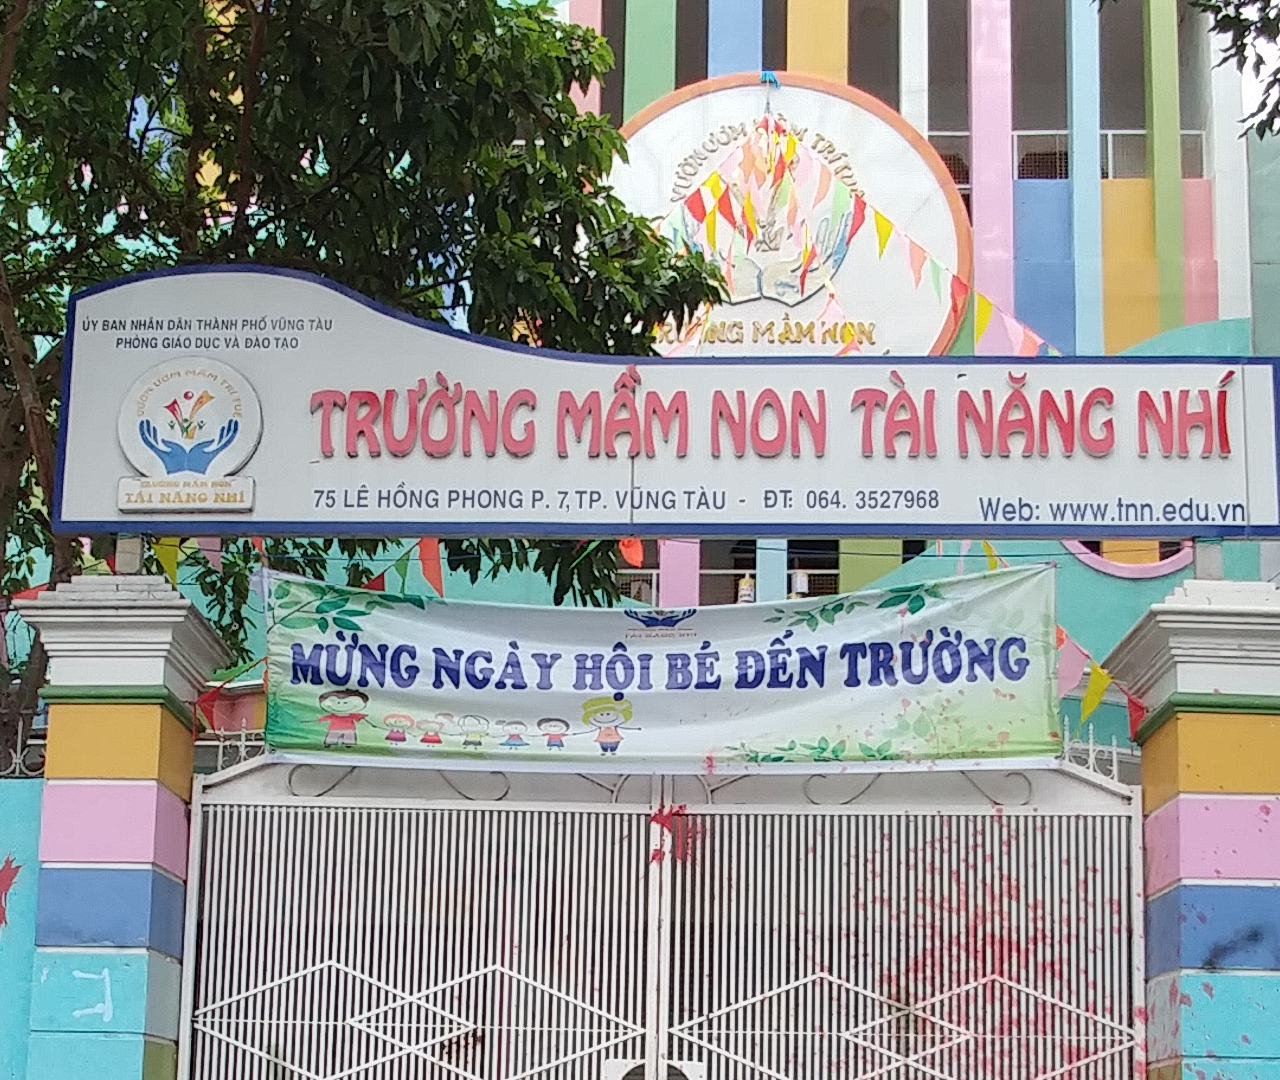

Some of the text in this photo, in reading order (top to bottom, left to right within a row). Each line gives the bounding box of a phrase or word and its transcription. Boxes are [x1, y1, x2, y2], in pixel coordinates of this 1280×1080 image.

[82, 315, 333, 331] ỦY BAN NHÂN DÂN THÀNH PHỐ VŨNG TÀU
[115, 335, 299, 351] PHÒNG GIÁO DỤC VÀ ĐÀO TẠO
[310, 364, 1235, 458] TRƯỜNG MẦM NON TÀI NĂNG NHÍ
[314, 489, 336, 509] 75
[343, 484, 369, 509] LÊ
[377, 482, 439, 509] HỒNG
[448, 489, 523, 509] PHONG
[531, 489, 550, 509] P.
[616, 485, 677, 510] VŨNG
[683, 484, 727, 509] TÀU
[763, 491, 794, 509] ĐT:
[806, 490, 847, 509] 064.
[855, 489, 940, 509] 3527968
[978, 497, 1246, 522] Web: www.tnn.edu.vn
[290, 625, 1030, 702] MỪNG NGÀY HỘI BÉ ĐẾN TRƯỜNG
